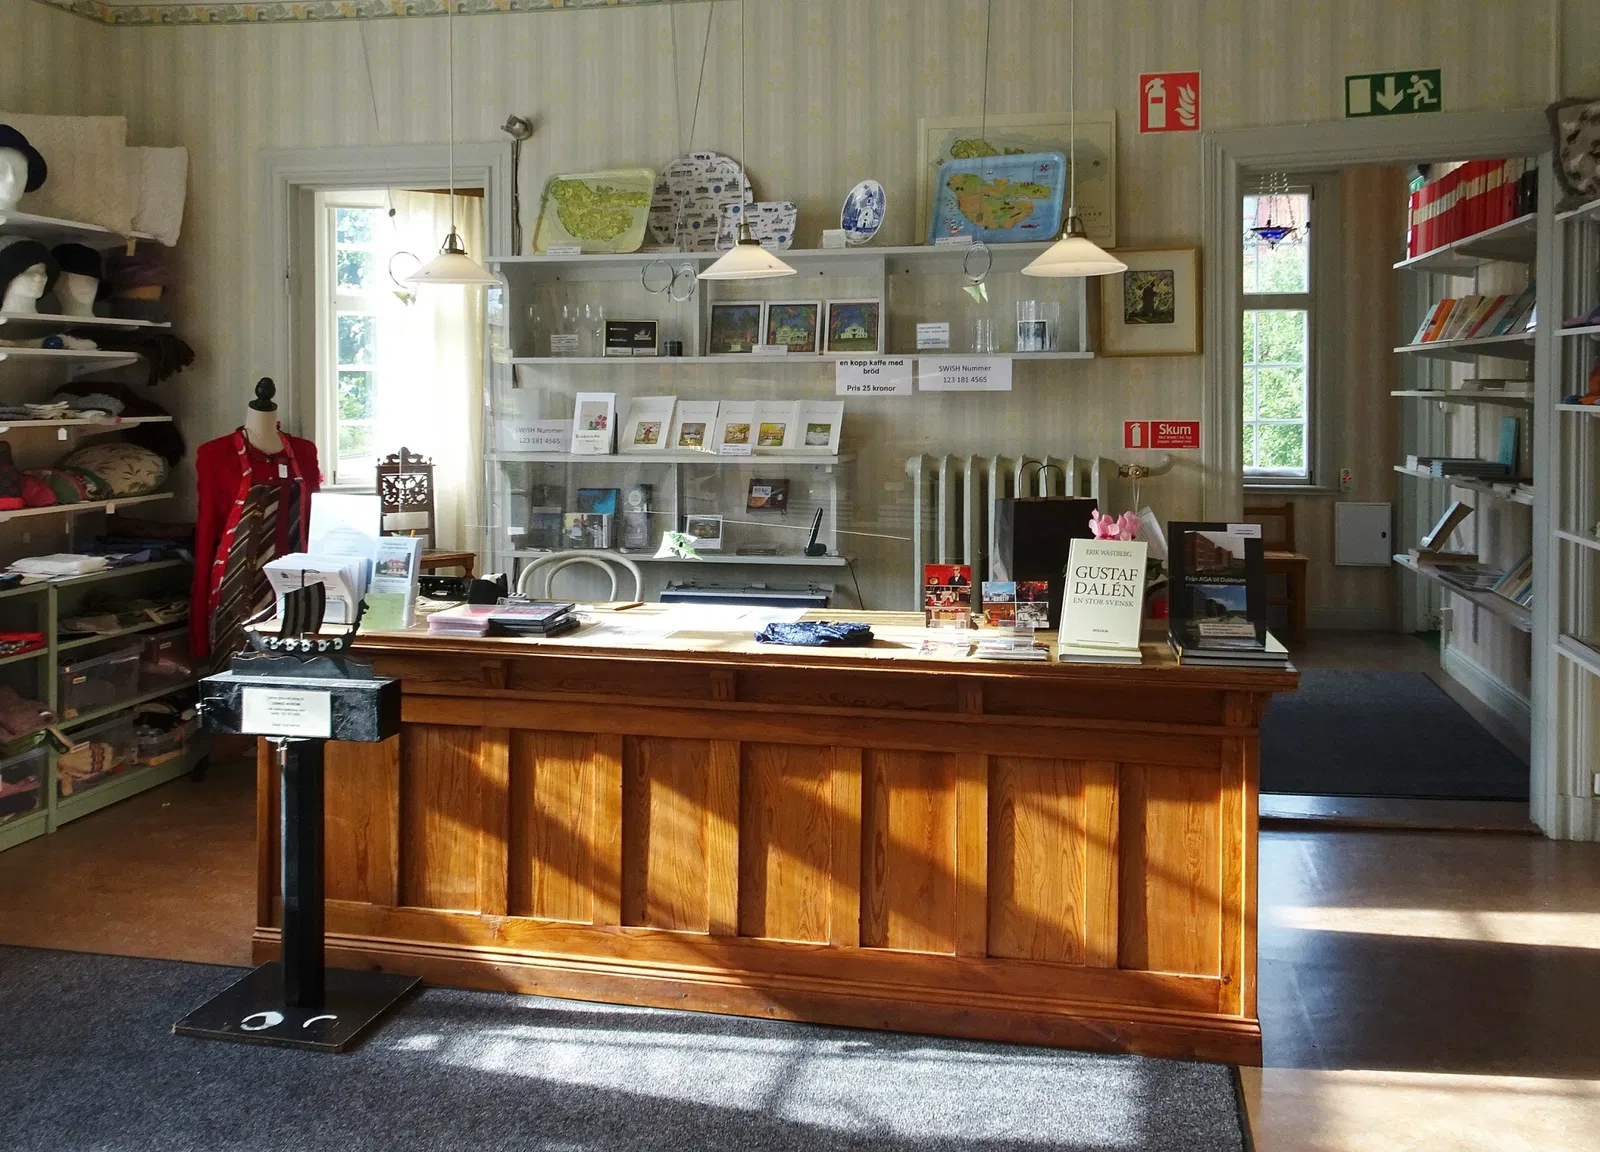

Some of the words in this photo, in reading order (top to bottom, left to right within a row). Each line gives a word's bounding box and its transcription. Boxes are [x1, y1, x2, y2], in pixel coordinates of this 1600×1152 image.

[850, 360, 868, 368] kopp
[1159, 423, 1191, 435] Skum
[1085, 548, 1100, 556] ERIK
[1101, 549, 1133, 558] WÄSTBERG
[1075, 565, 1139, 582] GUSTAF
[1074, 582, 1136, 598] DALÉN
[1085, 598, 1104, 606] STOR
[1105, 599, 1134, 608] SVENSK
